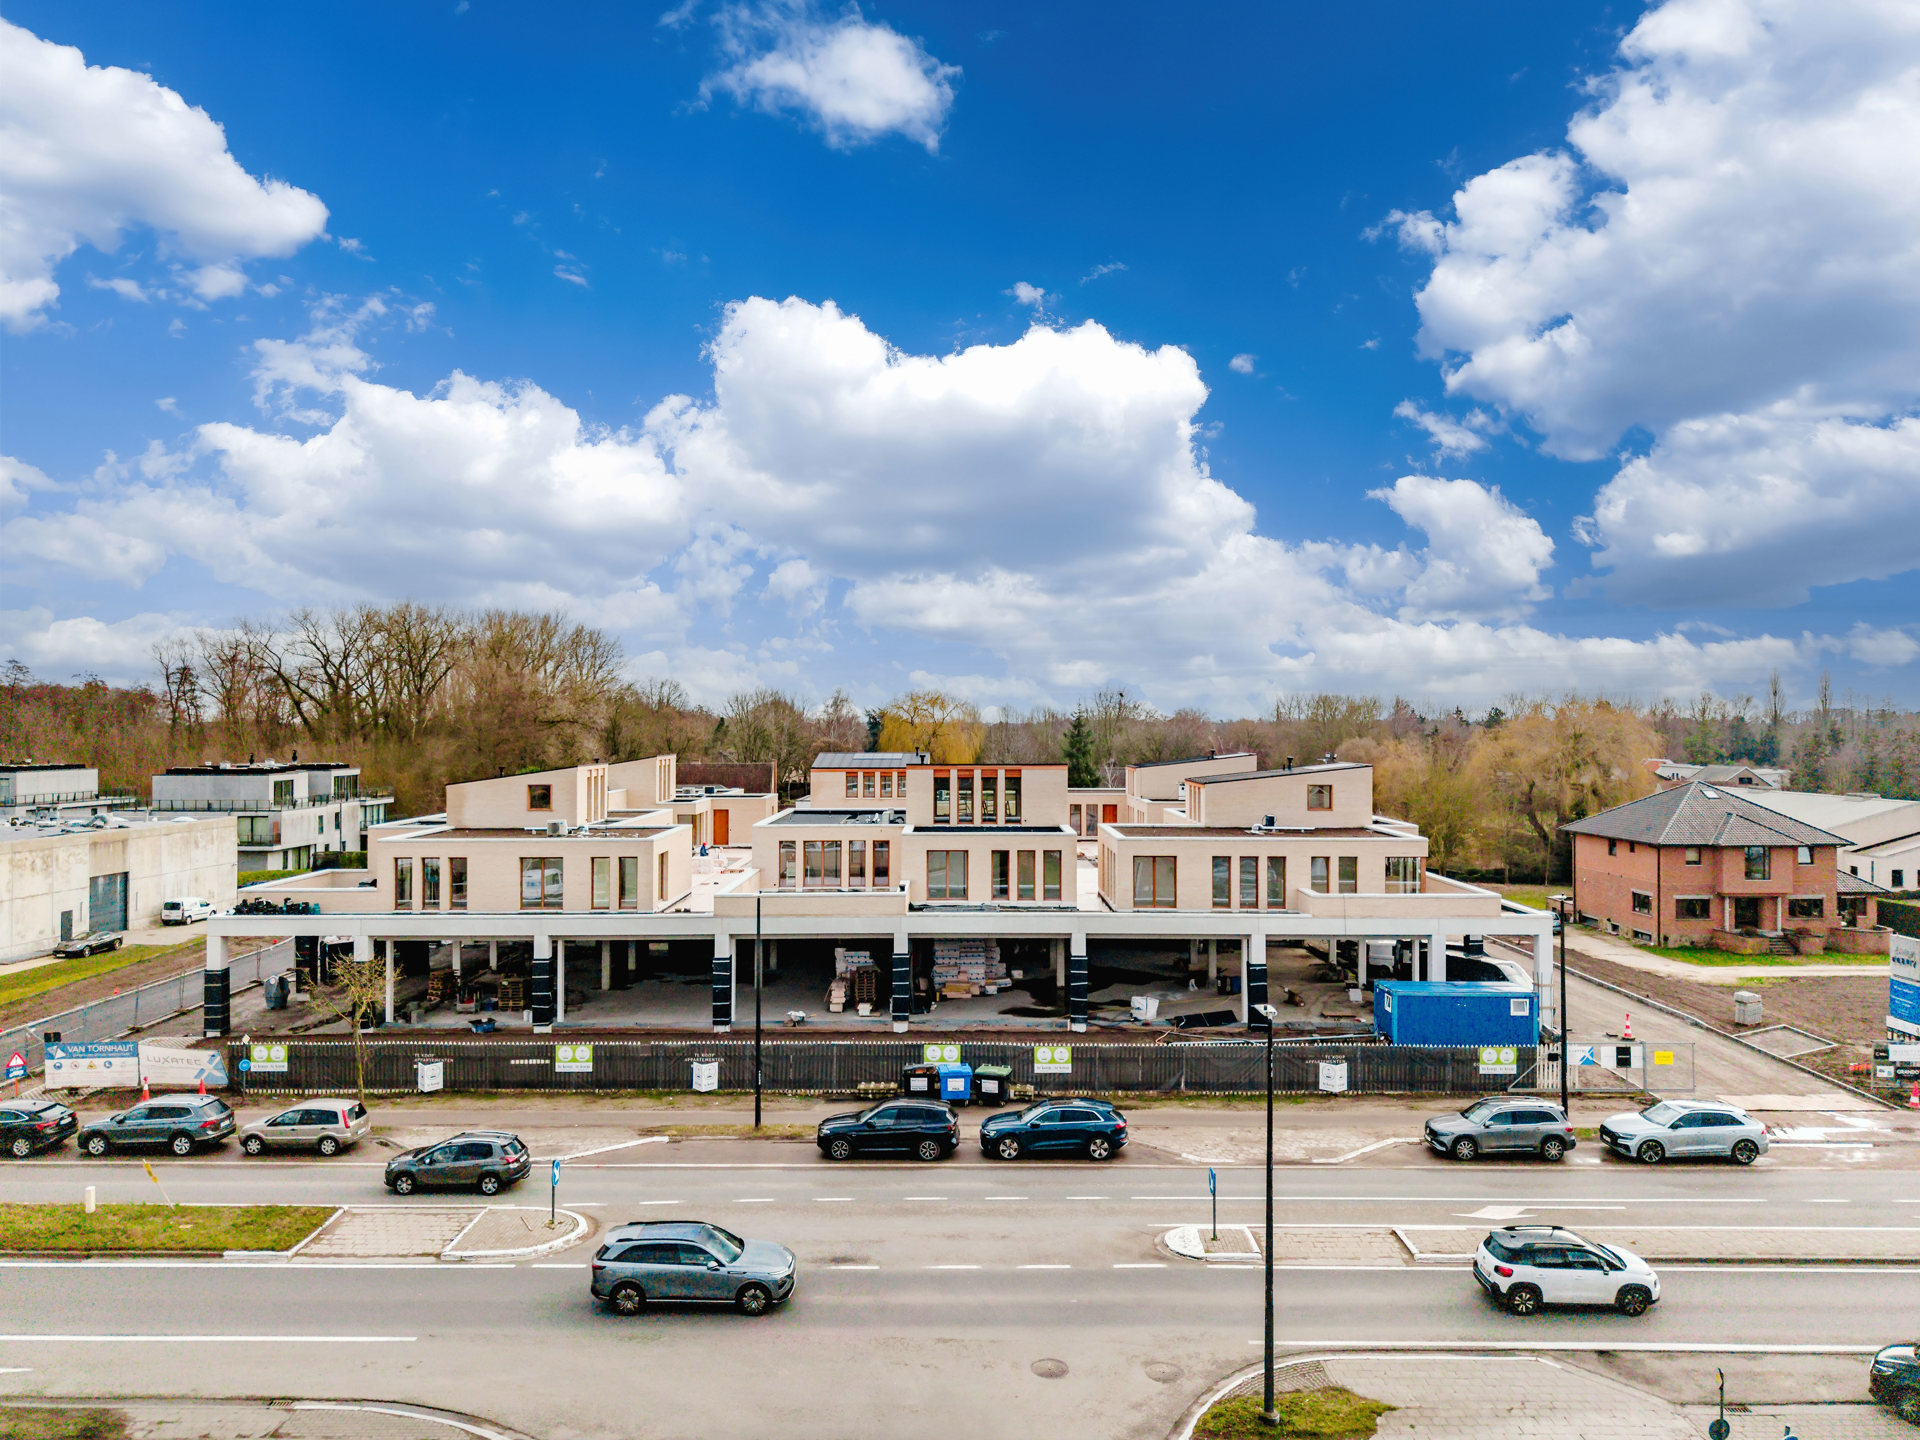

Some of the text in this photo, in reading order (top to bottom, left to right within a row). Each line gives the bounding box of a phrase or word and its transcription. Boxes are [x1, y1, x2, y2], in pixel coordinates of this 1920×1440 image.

[67, 1044, 134, 1053] VAN TORNHAUT
[146, 1056, 202, 1066] LUXATEC
